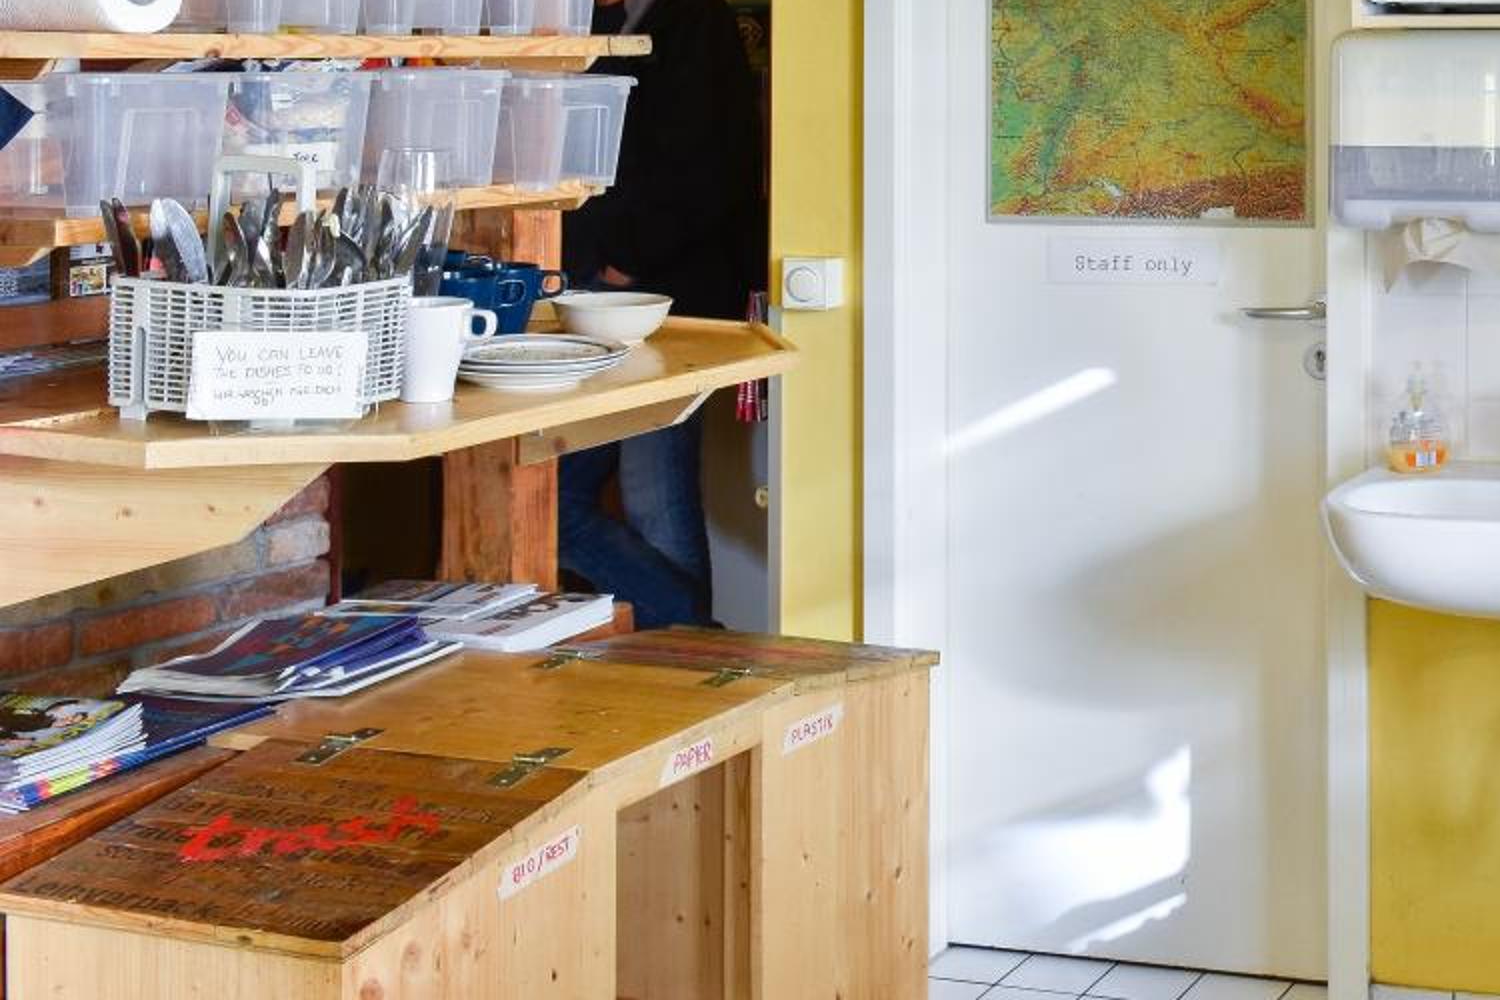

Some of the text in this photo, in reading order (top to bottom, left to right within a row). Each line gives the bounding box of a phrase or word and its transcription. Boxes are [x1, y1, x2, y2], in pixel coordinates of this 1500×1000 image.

[1074, 255, 1193, 276] Staff only
[216, 345, 344, 363] YOU CAN LEAVE
